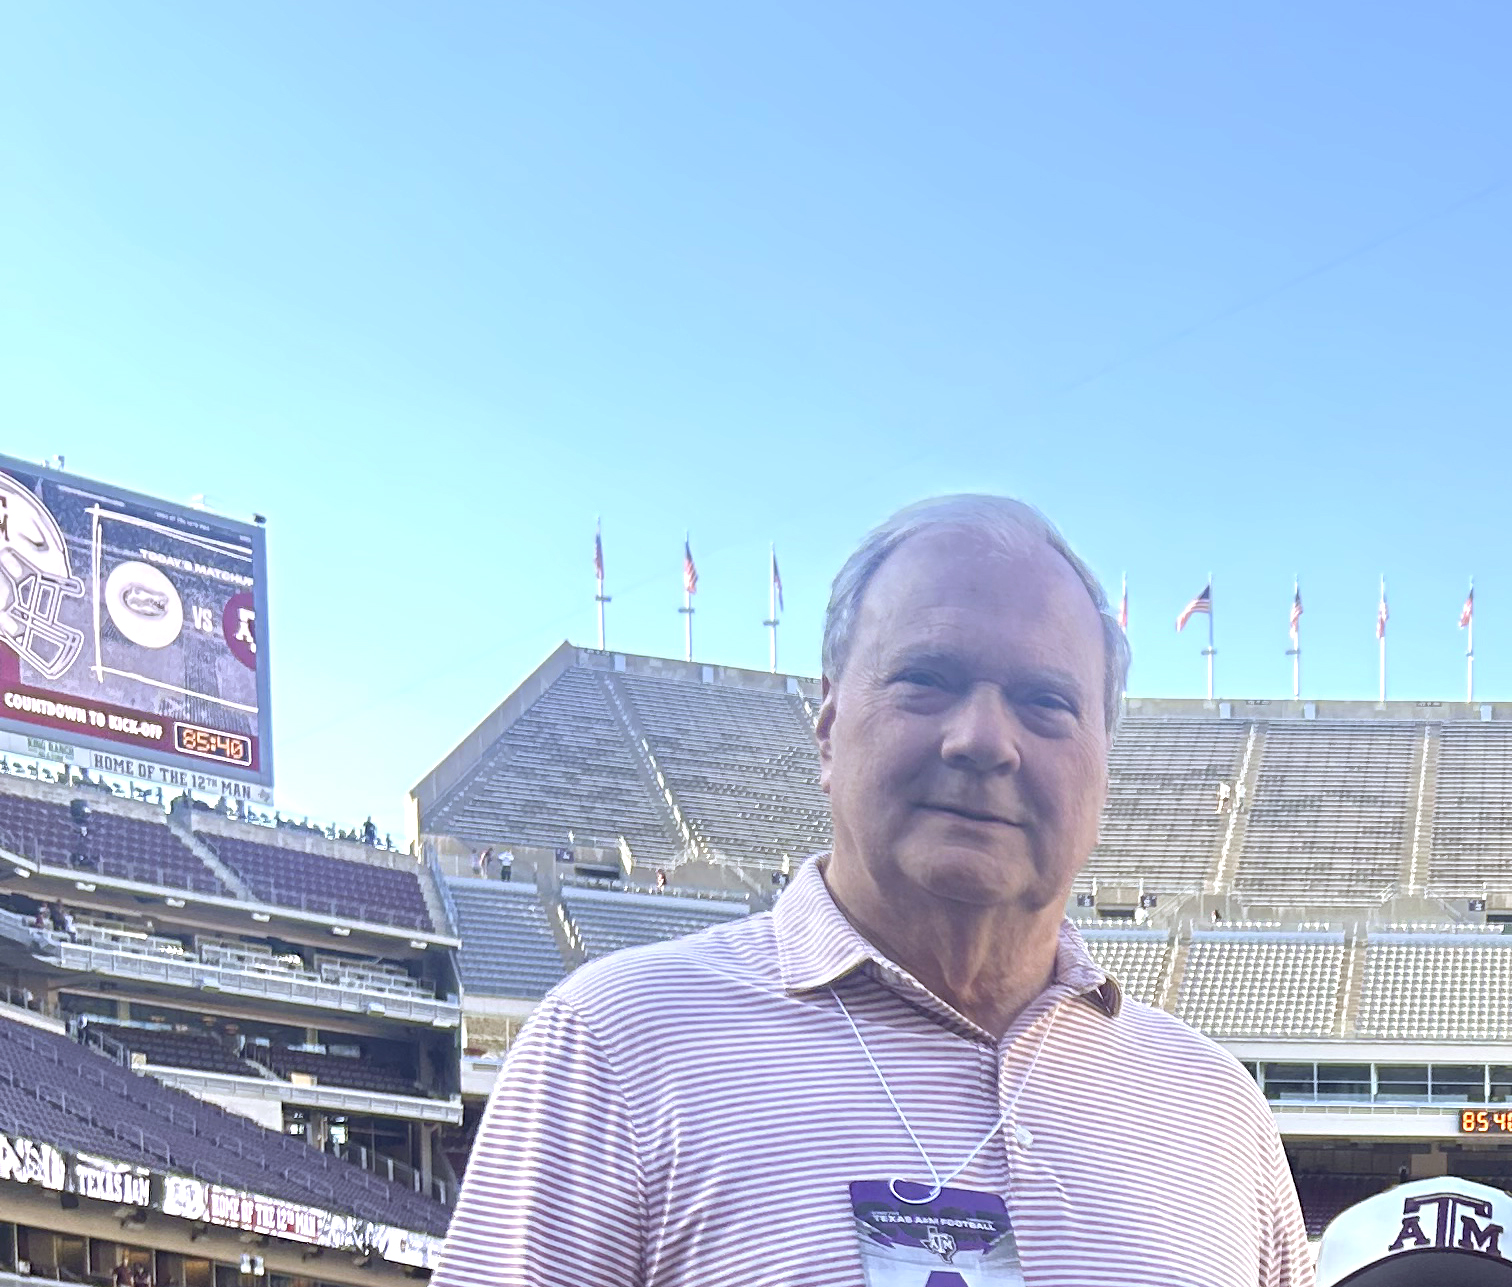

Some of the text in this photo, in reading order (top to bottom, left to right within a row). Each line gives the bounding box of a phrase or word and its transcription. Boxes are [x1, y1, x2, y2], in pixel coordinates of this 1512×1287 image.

[140, 549, 193, 572] TODAY'S
[192, 605, 213, 632] VS
[4, 692, 244, 759] COUNTDOWN TO KICK-OFF 85:40
[94, 753, 134, 776] HOME
[138, 764, 153, 780] OF
[159, 767, 188, 785] THE
[221, 781, 251, 799] MAN
[76, 1164, 123, 1203] TEXAS
[211, 1193, 240, 1224] HOME
[241, 1200, 254, 1228] OF
[256, 1203, 276, 1230] THE
[296, 1210, 318, 1237] MAN
[873, 1215, 913, 1224] TEXAS
[915, 1216, 939, 1225] A&M
[941, 1218, 997, 1231] FOOTBALL
